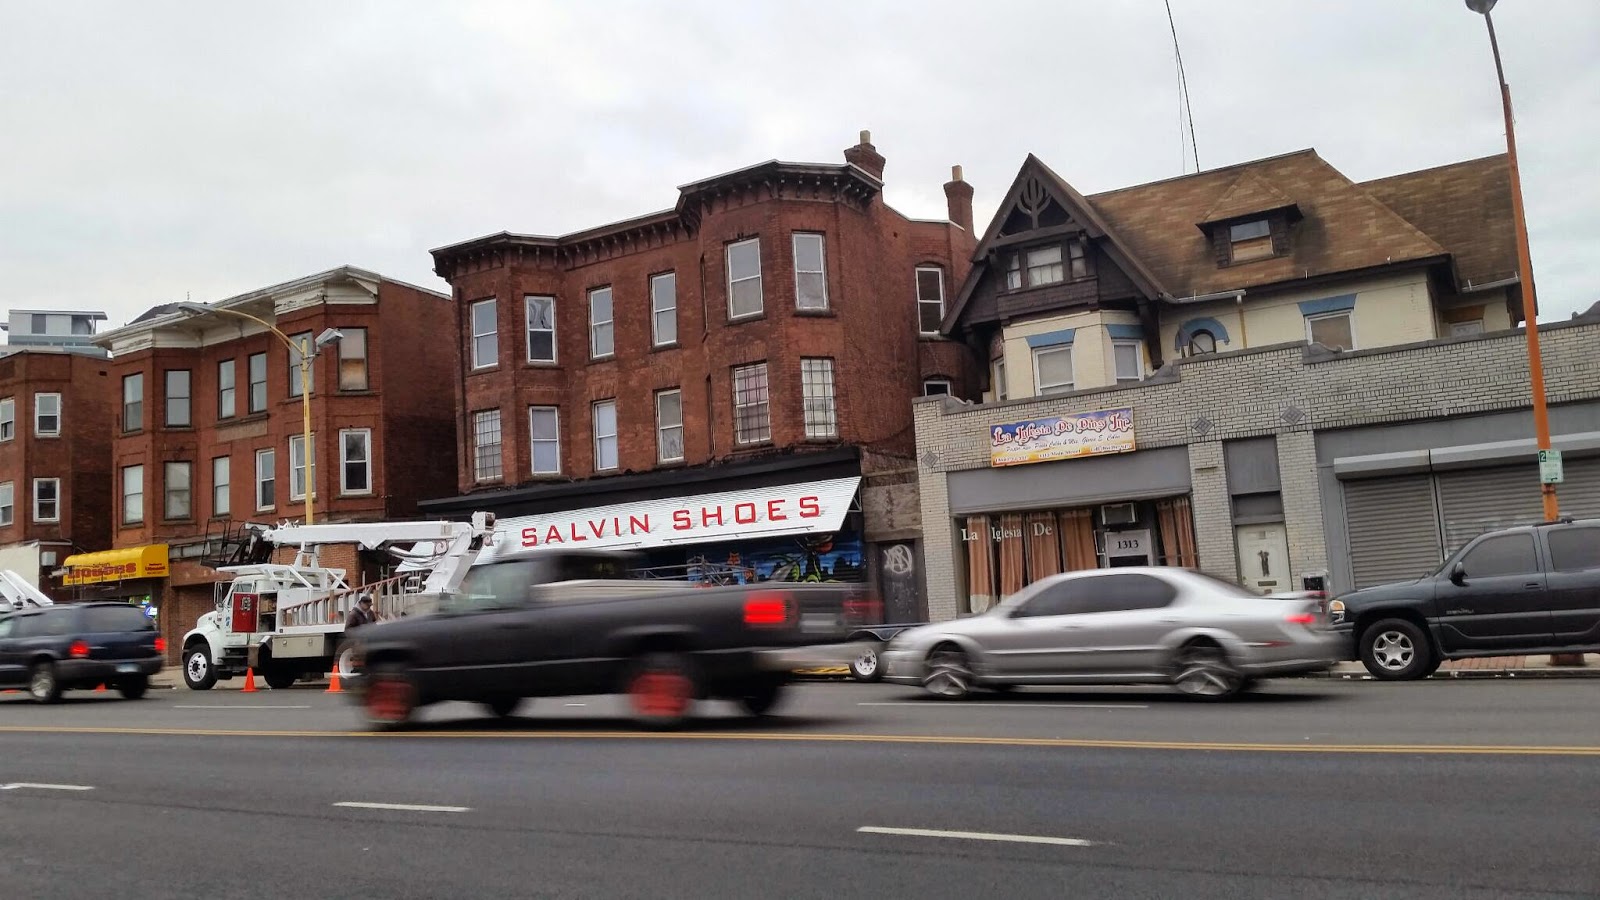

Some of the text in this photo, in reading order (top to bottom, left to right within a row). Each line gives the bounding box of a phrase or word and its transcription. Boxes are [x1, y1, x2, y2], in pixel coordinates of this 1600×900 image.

[992, 412, 1133, 446] La Iglesia De Dios Inc.
[521, 496, 820, 547] SALVIN SHOES
[961, 522, 1052, 542] La Iglesia De
[1117, 539, 1139, 550] 1313
